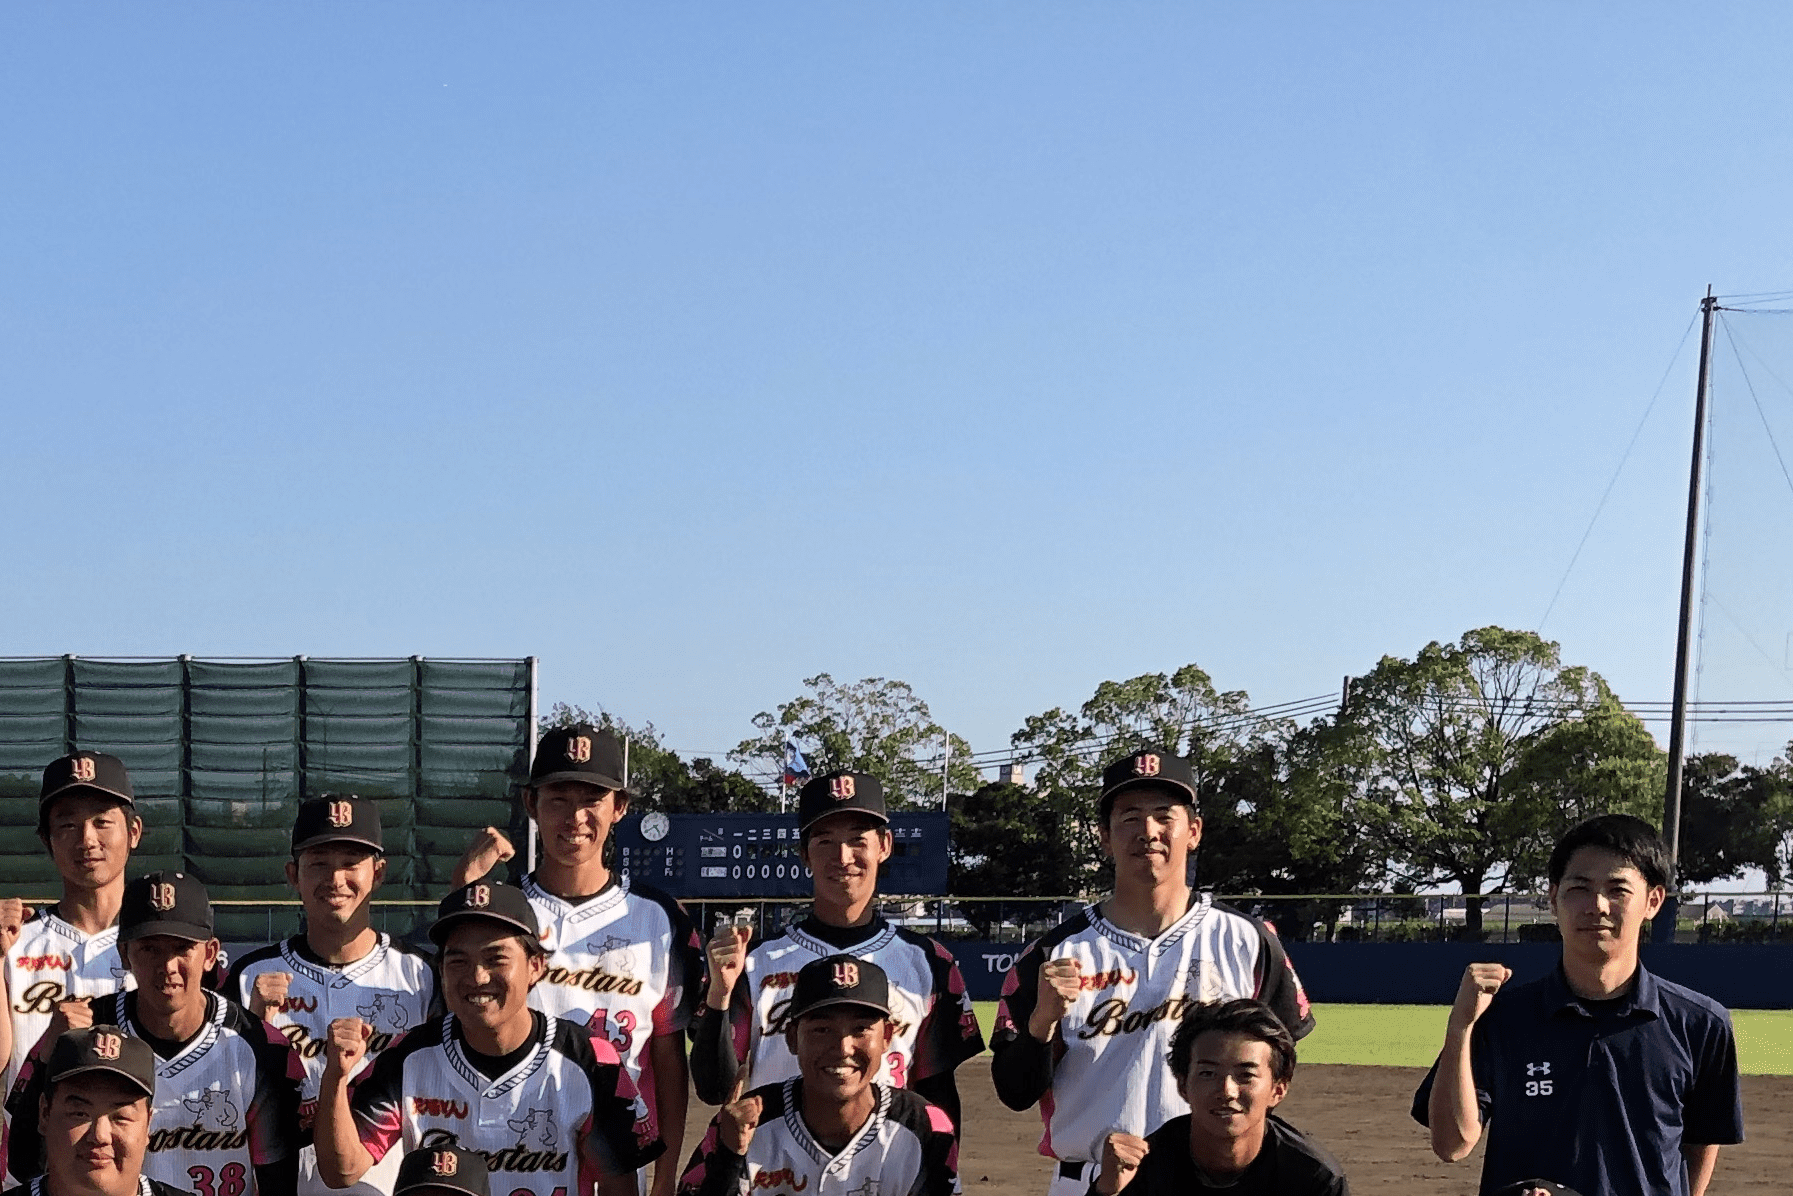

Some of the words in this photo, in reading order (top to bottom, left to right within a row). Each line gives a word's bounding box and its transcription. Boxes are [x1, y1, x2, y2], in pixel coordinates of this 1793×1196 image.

[732, 865, 741, 879] 0
[746, 864, 755, 878] 0
[761, 864, 770, 878] 0
[776, 863, 785, 878] 0
[790, 864, 799, 879] 0
[982, 953, 1018, 973] TO
[542, 964, 645, 996] ostars
[586, 1008, 637, 1052] 43
[1525, 1080, 1553, 1097] 35
[148, 1125, 247, 1153] ostars
